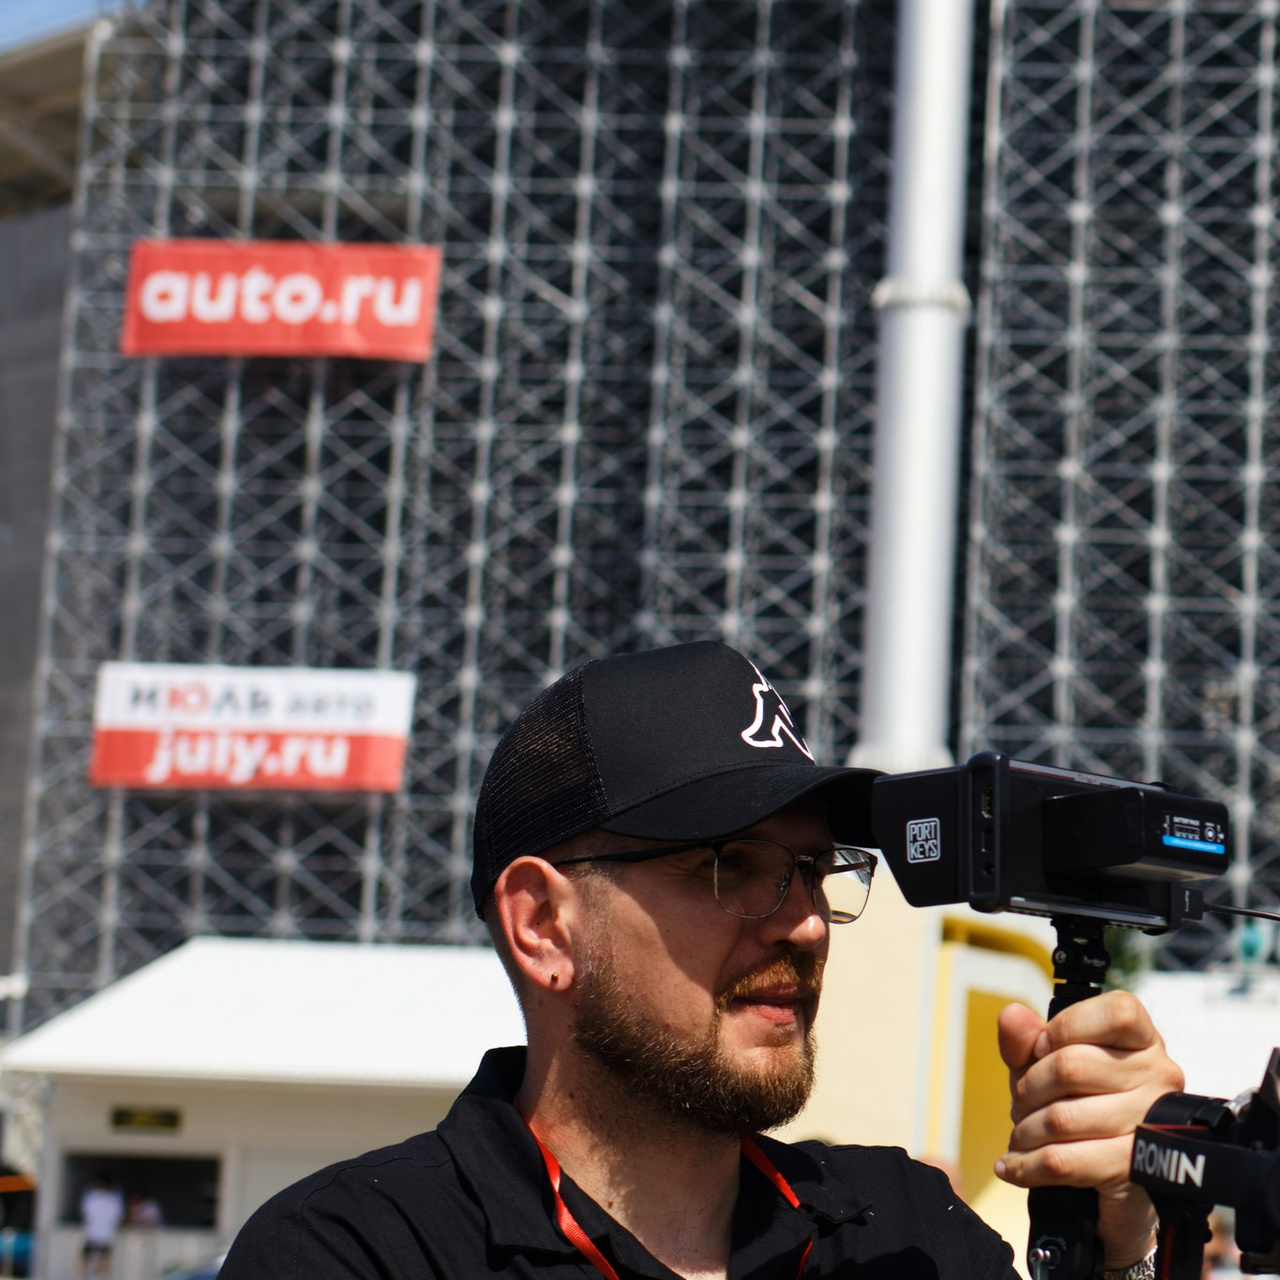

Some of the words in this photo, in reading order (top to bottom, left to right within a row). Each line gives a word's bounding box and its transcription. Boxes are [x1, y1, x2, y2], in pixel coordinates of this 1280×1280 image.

[140, 265, 423, 325] auto.ru
[143, 728, 349, 785] july.ru
[910, 821, 937, 841] PORT
[910, 839, 938, 859] KEYS
[1133, 1138, 1206, 1189] RONIN
